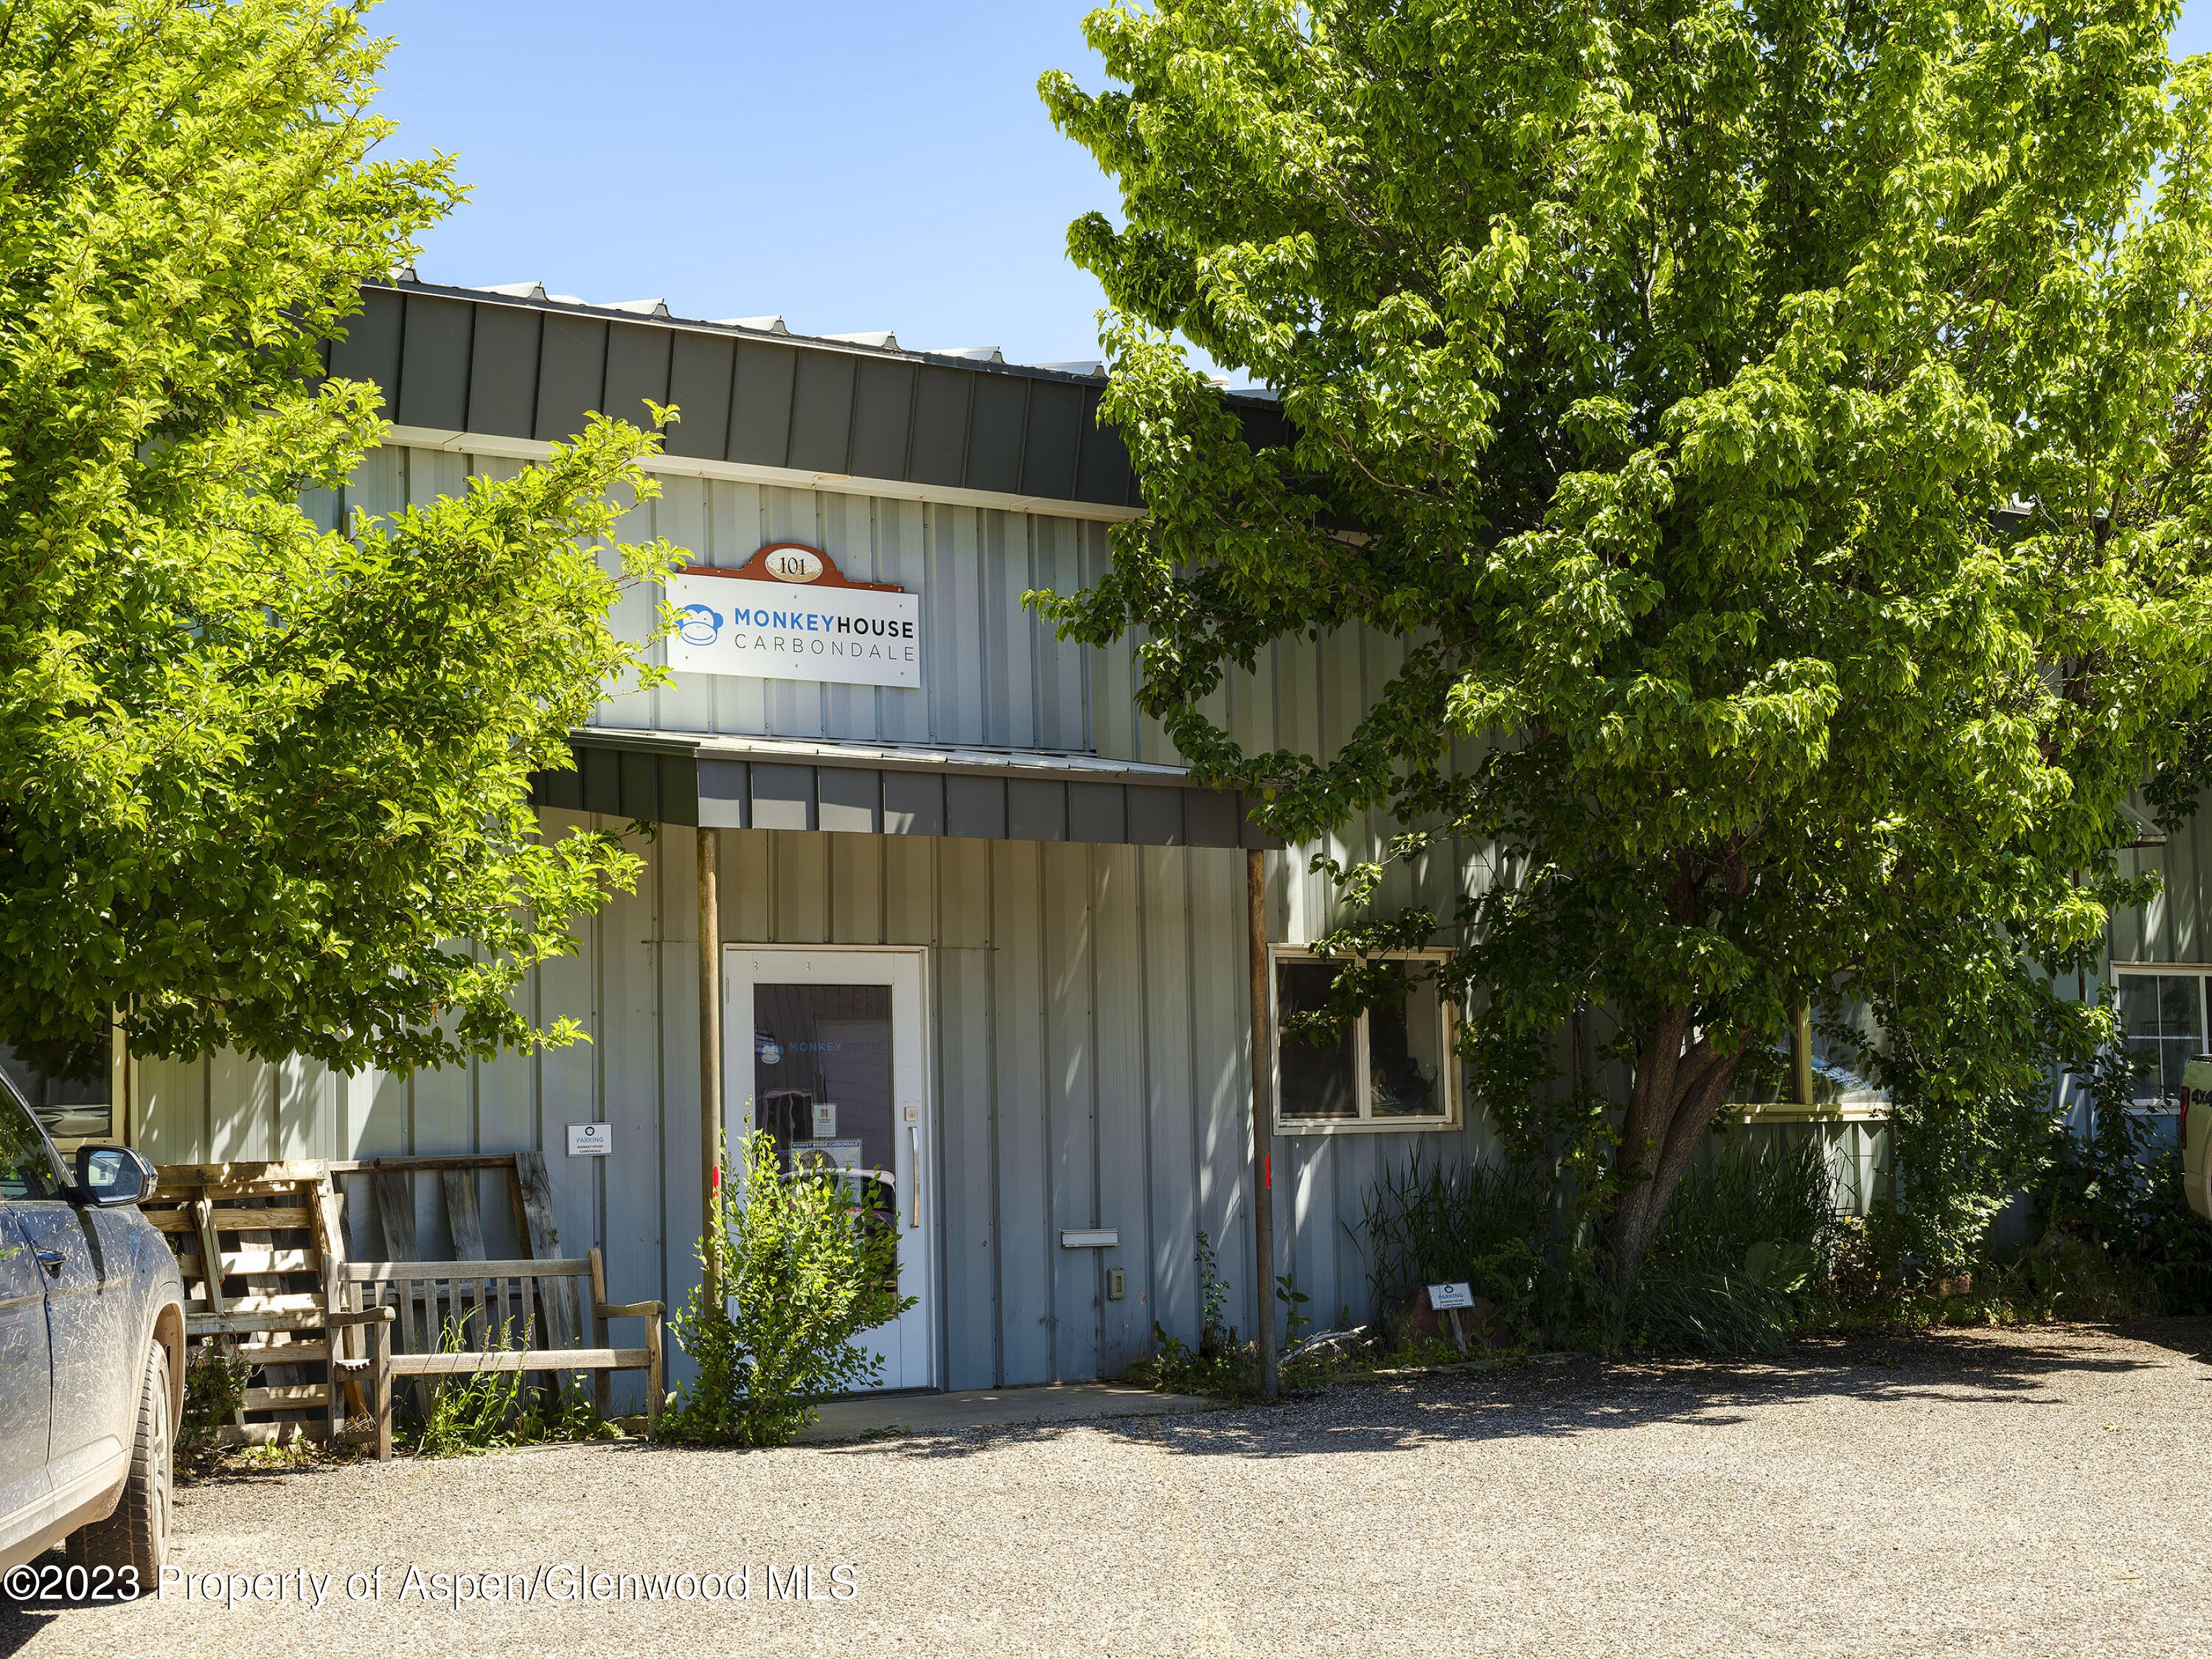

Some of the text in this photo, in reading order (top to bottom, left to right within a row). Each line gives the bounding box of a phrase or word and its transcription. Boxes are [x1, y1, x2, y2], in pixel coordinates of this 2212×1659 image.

[779, 556, 807, 577] 101
[734, 607, 914, 639] MONKEYHOUSE
[734, 633, 914, 662] CARBONDALE
